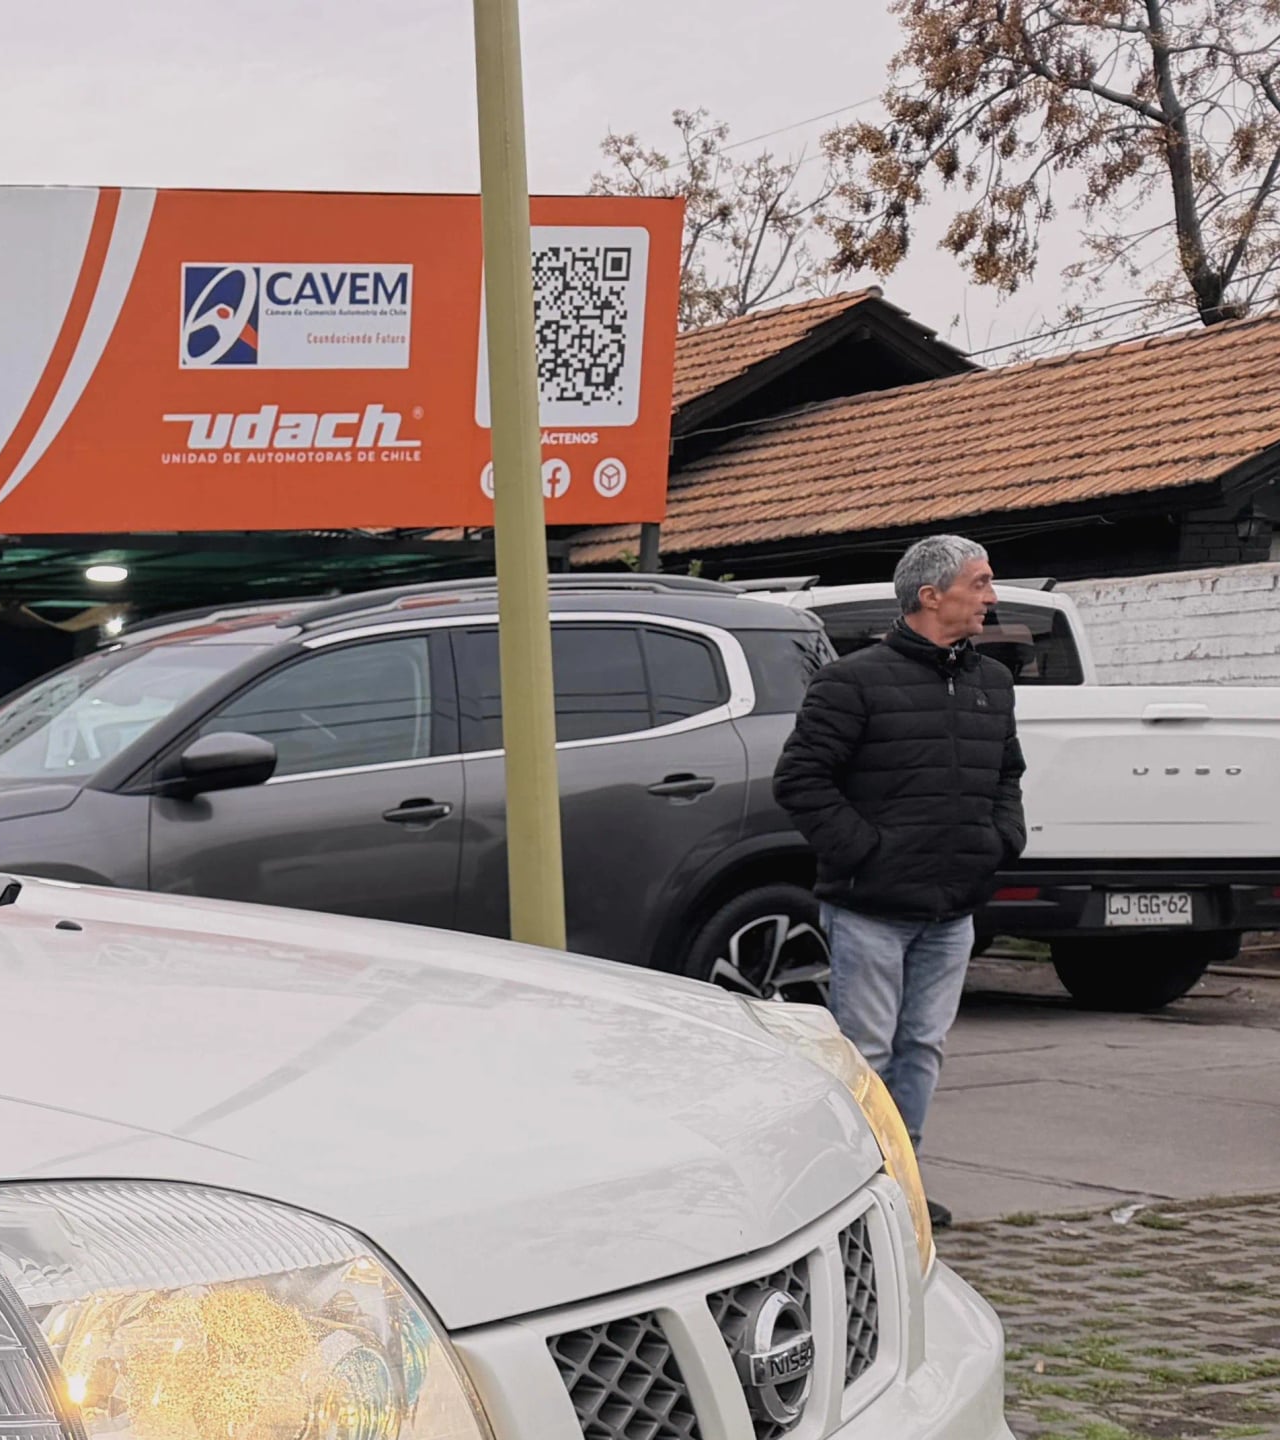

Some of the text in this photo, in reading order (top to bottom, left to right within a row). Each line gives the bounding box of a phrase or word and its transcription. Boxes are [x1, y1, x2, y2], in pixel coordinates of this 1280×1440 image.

[265, 271, 409, 306] CAVEM
[162, 403, 422, 449] udach
[541, 430, 599, 445] ÁCTENOS
[161, 450, 421, 464] UNIDAD DE AUTOMOTORAS DE CHILE
